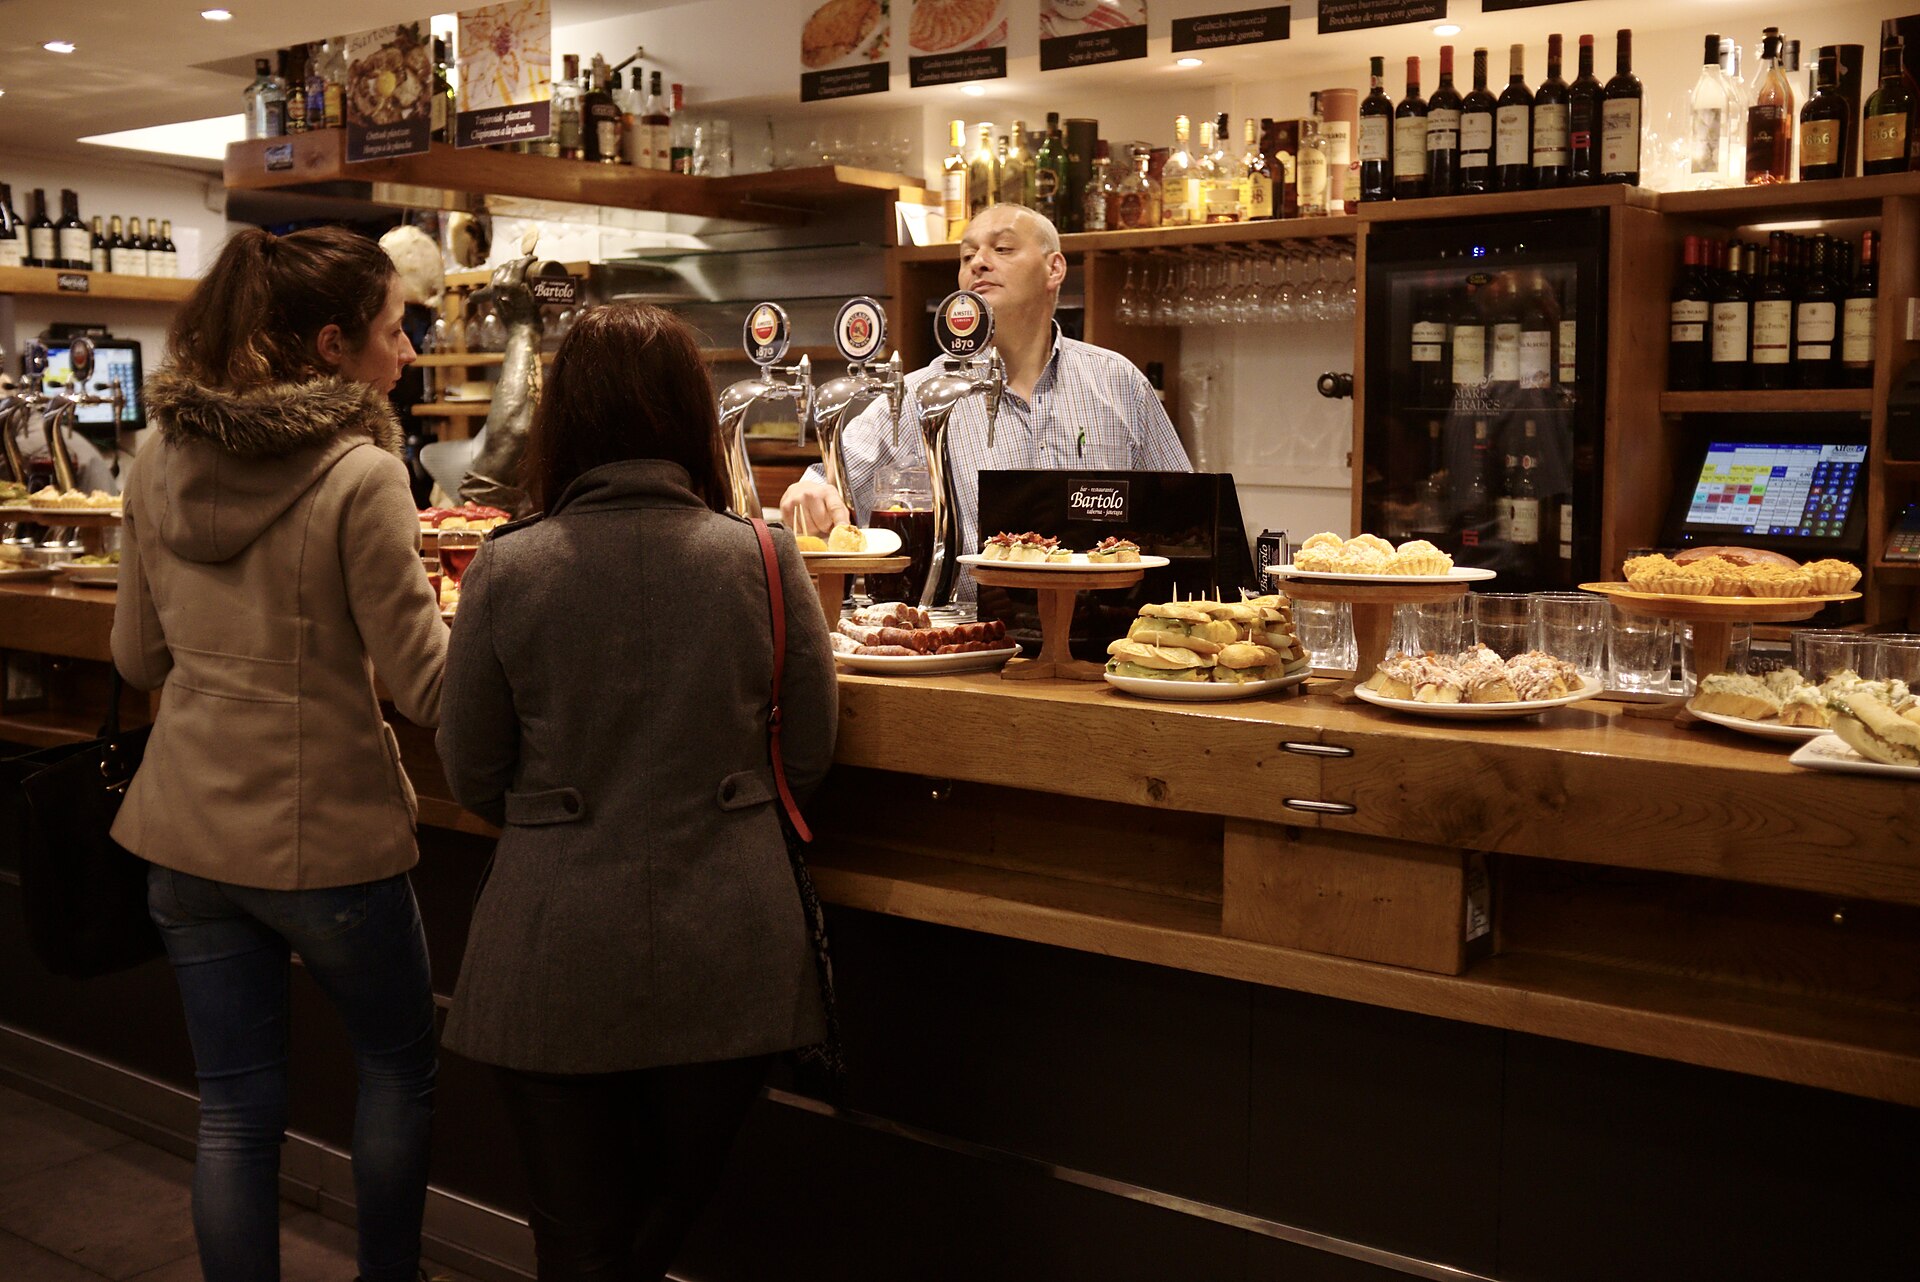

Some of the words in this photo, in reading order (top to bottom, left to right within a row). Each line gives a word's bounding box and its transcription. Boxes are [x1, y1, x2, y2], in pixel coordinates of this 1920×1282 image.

[533, 283, 574, 299] Bartolo
[953, 310, 974, 319] AMSTEL
[951, 337, 976, 351] 1870
[755, 345, 775, 358] 1870
[1079, 485, 1088, 493] bar
[1070, 489, 1124, 509] Bartolo
